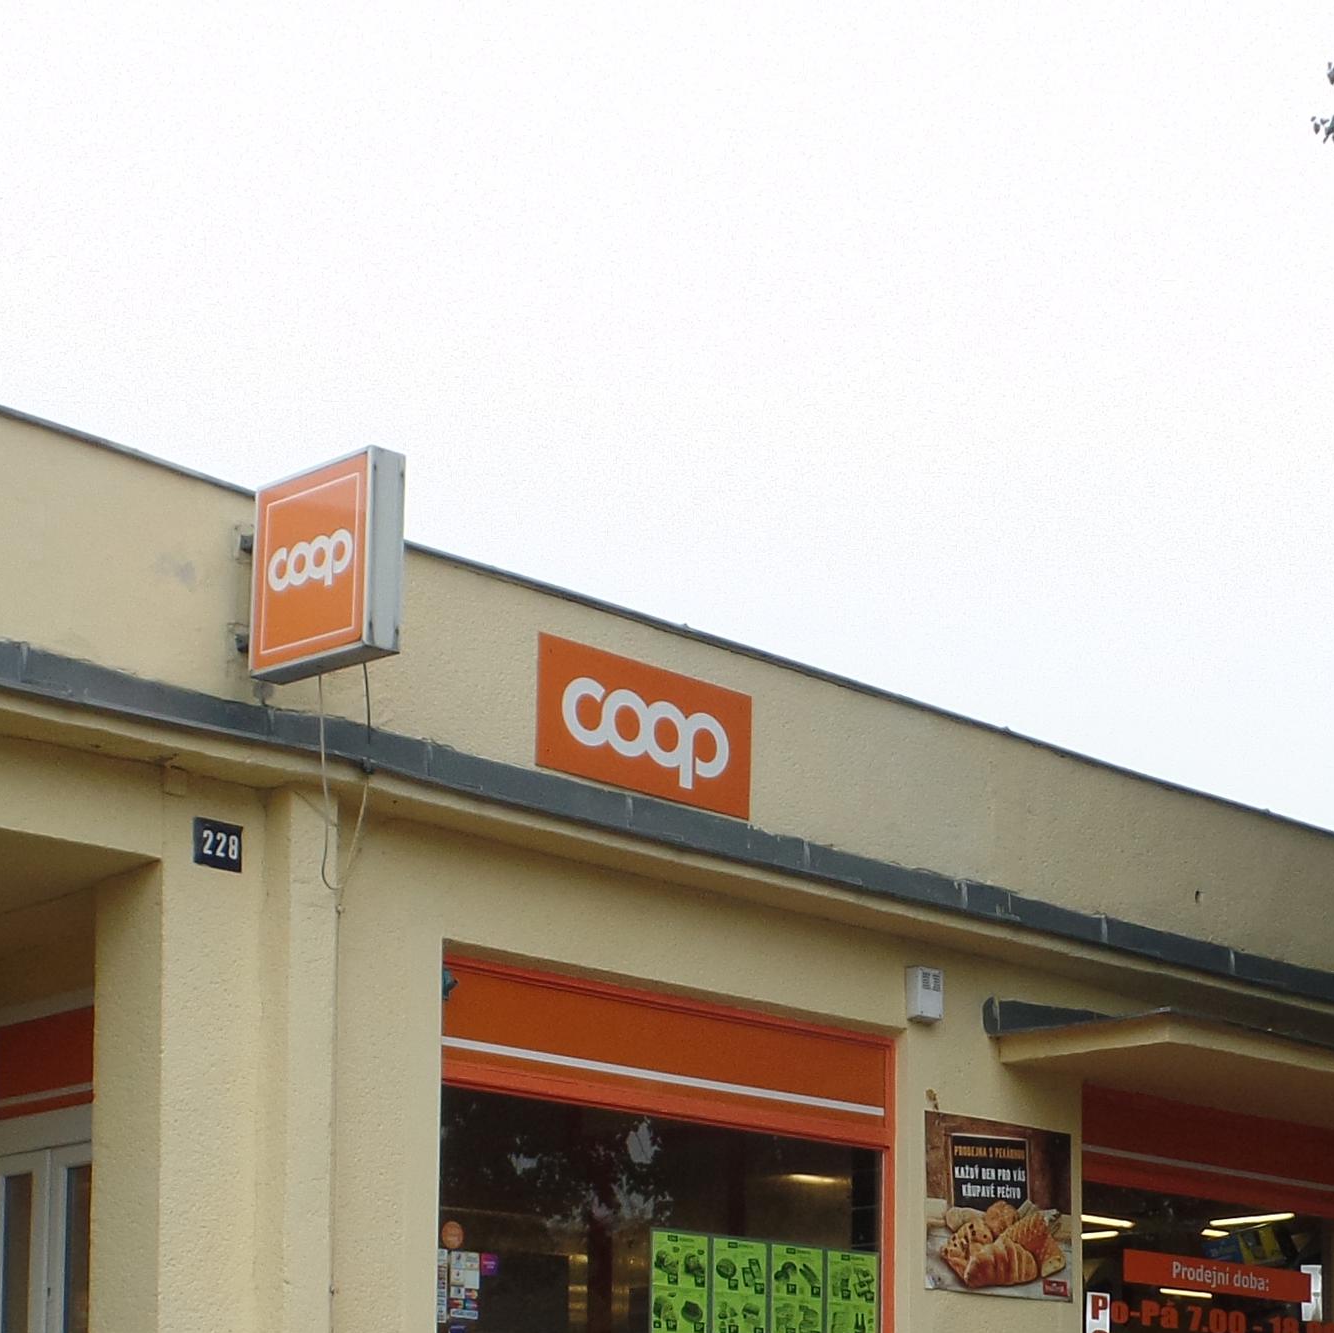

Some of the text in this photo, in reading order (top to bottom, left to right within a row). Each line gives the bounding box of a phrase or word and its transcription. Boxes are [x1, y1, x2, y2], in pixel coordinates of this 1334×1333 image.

[268, 529, 353, 592] coop
[561, 677, 730, 790] coop
[202, 829, 239, 861] 228
[954, 1164, 979, 1179] KAŽDÝ
[997, 1168, 1011, 1181] PRO
[1012, 1166, 1026, 1182] VÁS
[962, 1182, 1021, 1199] KŘUPAVÉ PEČIVO
[1172, 1261, 1270, 1292] Prodejní doba:
[1091, 1294, 1179, 1330] Po-Pá
